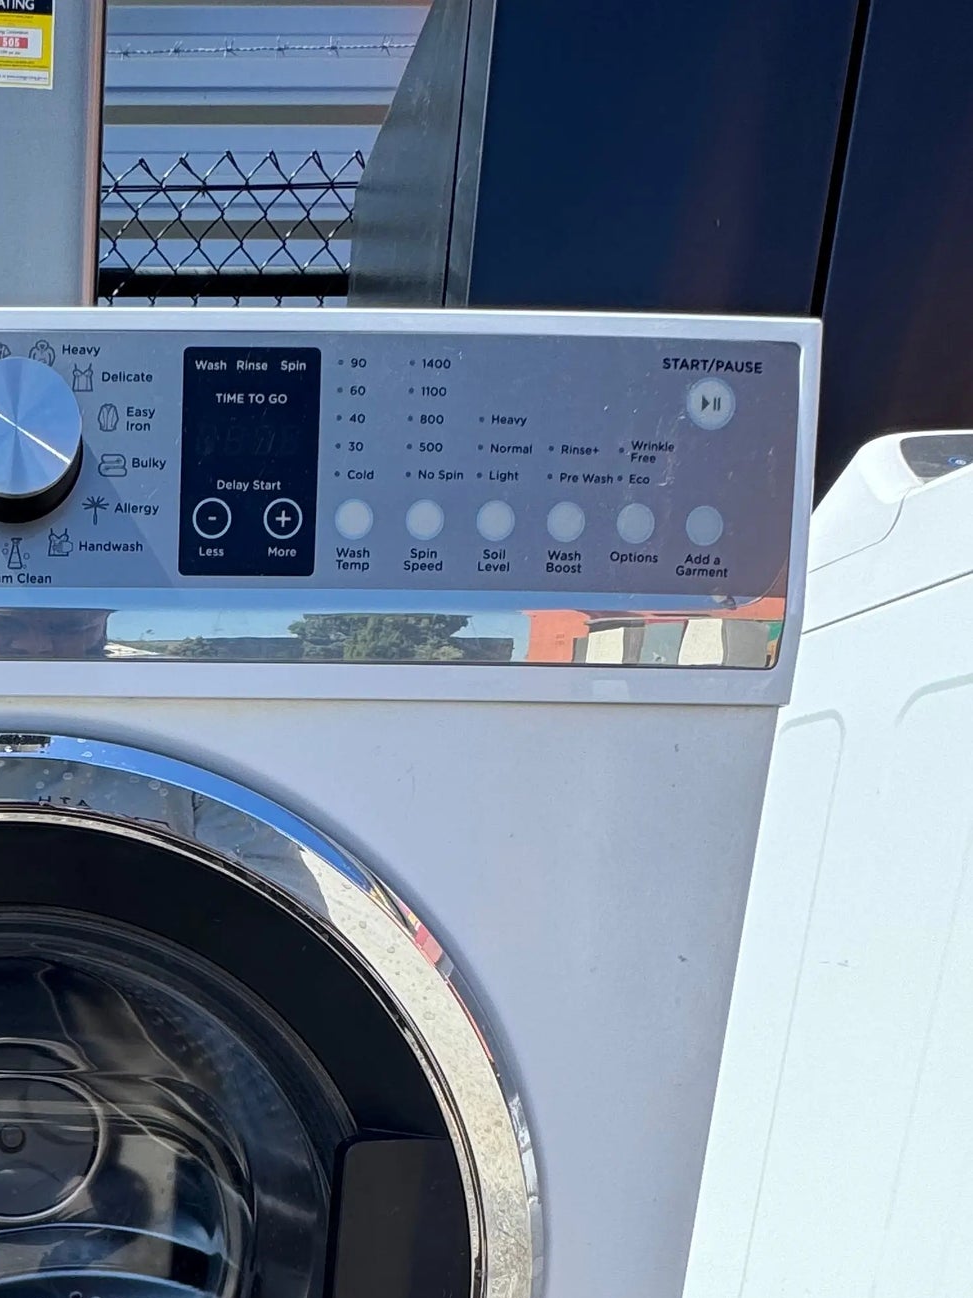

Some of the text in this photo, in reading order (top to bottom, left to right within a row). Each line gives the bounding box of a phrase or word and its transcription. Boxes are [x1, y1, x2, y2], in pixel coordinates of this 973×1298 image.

[62, 344, 100, 357] Heavy
[195, 360, 307, 372] Wash Rinse Spin
[351, 358, 367, 368] 90
[422, 359, 451, 369] 1400
[662, 358, 763, 374] START/PAUSE
[101, 371, 153, 382] Delicate
[350, 386, 366, 396] 60
[421, 386, 447, 397] 1100
[216, 393, 287, 404] TIME TO GO
[126, 406, 155, 419] Easy
[349, 414, 366, 424] 40
[420, 414, 444, 424] 800
[491, 414, 528, 427] Heavy
[126, 420, 151, 431] Iron
[348, 442, 364, 452] 30
[419, 442, 443, 452] 500
[490, 443, 532, 454] Normal
[561, 444, 600, 455] Rinse+
[631, 441, 675, 452] Wrinkle
[630, 453, 656, 463] Free
[131, 458, 166, 470] Bulky
[347, 470, 374, 480] Cold
[418, 470, 464, 482] No Spin
[489, 471, 519, 483] Light
[559, 473, 613, 484] Pre Wash
[629, 474, 650, 485] Eco
[217, 480, 281, 492] Delay Start
[114, 502, 159, 516] Allergy
[79, 541, 143, 552] Handwash
[199, 547, 224, 557] Less
[267, 547, 297, 557] More
[336, 548, 370, 559] Wash
[410, 549, 438, 561] Spin
[483, 549, 506, 560] Soil
[548, 551, 581, 561] Wash
[610, 552, 659, 564] Options
[684, 554, 721, 565] Add a
[336, 560, 370, 572] Temp
[404, 560, 443, 573] Speed
[477, 561, 510, 573] Level
[546, 563, 582, 574] Boost
[675, 566, 728, 578] Garment
[17, 572, 52, 584] Clean
